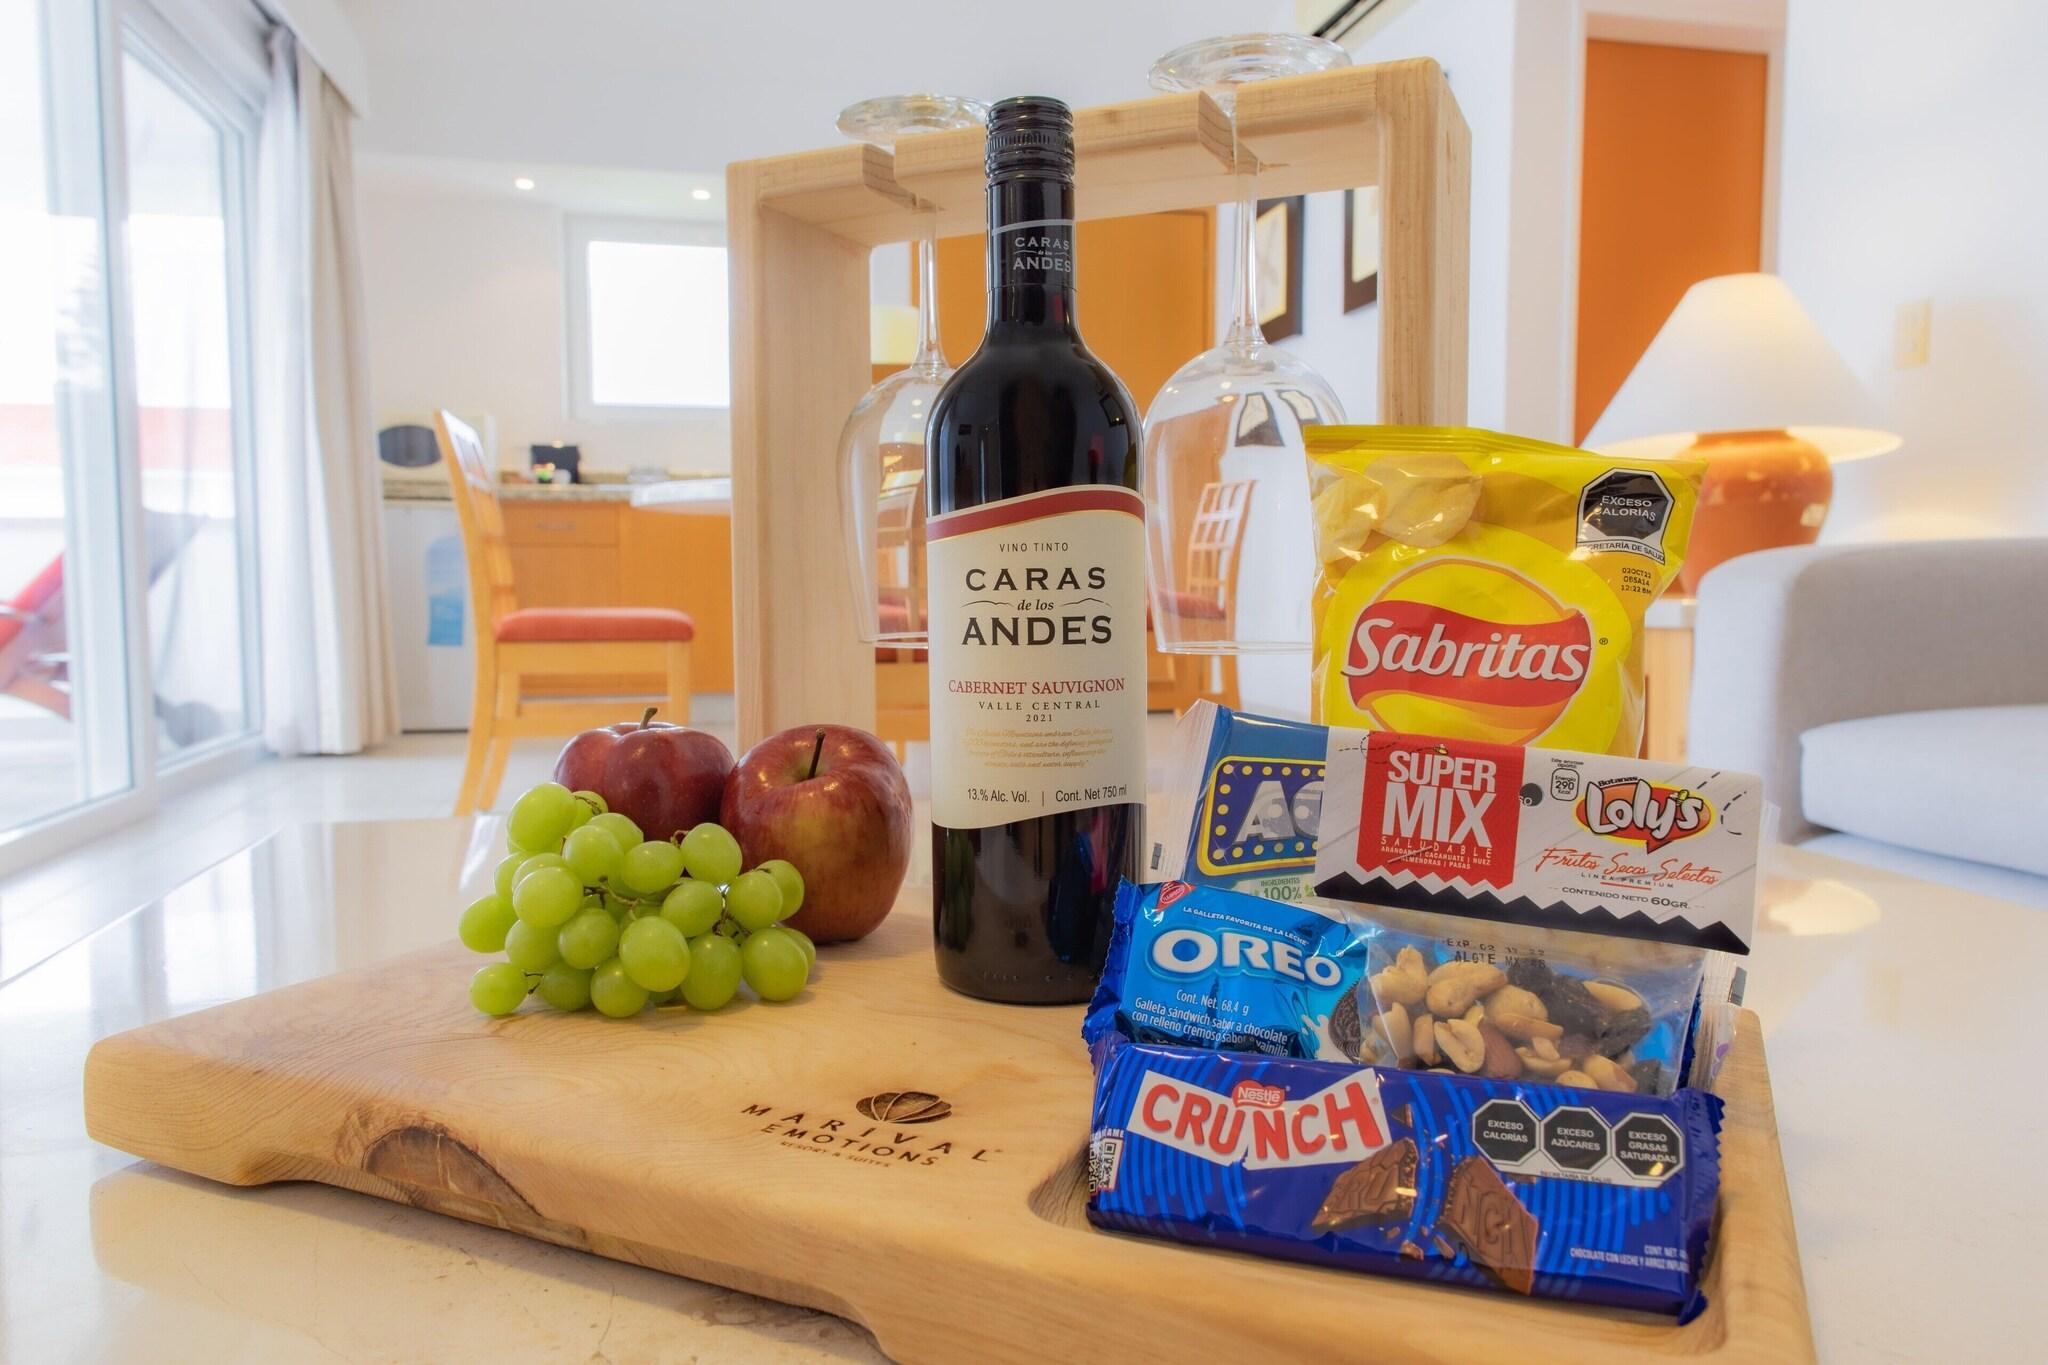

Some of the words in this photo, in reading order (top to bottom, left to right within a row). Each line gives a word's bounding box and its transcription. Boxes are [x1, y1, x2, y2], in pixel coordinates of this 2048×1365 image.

[1014, 236, 1070, 250] CARAS
[1012, 256, 1072, 273] ANDES
[1601, 495, 1652, 508] EXCESO
[999, 543, 1028, 553] VINO
[1033, 542, 1069, 552] TINTO
[1580, 541, 1630, 551] CRETARÍA
[965, 566, 1107, 592] CARAS
[1017, 599, 1033, 611] de
[1035, 599, 1055, 611] los
[961, 615, 1112, 647] ANDES
[1341, 618, 1592, 683] Sabritas
[949, 680, 1027, 695] CABERNET
[1031, 678, 1125, 695] SAUVIGNON
[979, 701, 1023, 711] VALLE
[1032, 700, 1101, 711] CENTRAL
[1025, 714, 1053, 722] 2021
[1387, 750, 1497, 793] SUPER
[1555, 780, 1575, 791] 290
[1598, 776, 1638, 787] Botanas
[990, 789, 1009, 802] Alc.
[1010, 790, 1030, 803] Vol.
[1055, 790, 1082, 802] Cont.
[1084, 788, 1100, 801] Net
[1102, 785, 1117, 799] 750
[1118, 784, 1127, 796] ml
[1382, 781, 1497, 848] MIX
[1585, 779, 1704, 839] Loly's
[1381, 836, 1493, 858] SALUDABLE
[1424, 851, 1465, 863] CACAHUATE
[1472, 857, 1491, 866] NUEZ
[1449, 861, 1471, 869] PASAS
[1260, 877, 1301, 887] INGREDIENTES
[1581, 872, 1615, 882] LINEA
[1620, 877, 1675, 889] PREMIUM
[1263, 885, 1302, 901] 100%
[1562, 886, 1621, 900] CONTENIDO
[1621, 894, 1649, 903] NETO
[1193, 909, 1225, 921] GALLETA
[1225, 915, 1262, 930] FAVORITA
[1262, 925, 1273, 933] DE
[1274, 928, 1284, 936] LA
[1152, 929, 1343, 987] OREO
[1176, 989, 1198, 1005] Cont.
[1201, 995, 1219, 1010] Net.
[1242, 1004, 1250, 1016] g
[1135, 997, 1167, 1016] Galleta
[1167, 1006, 1211, 1026] sándwich
[1211, 1016, 1234, 1031] sabor
[1235, 1021, 1242, 1032] a
[1243, 1023, 1289, 1046] chocolate
[1131, 1010, 1148, 1023] con
[1149, 1014, 1182, 1033] relleno
[1182, 1023, 1222, 1042] cremoso
[1254, 1039, 1289, 1057] vainilla
[1141, 1080, 1385, 1162] CRUNCH
[1487, 1119, 1524, 1131] EXCESO
[740, 1103, 989, 1162] MARIVAL
[1483, 1130, 1529, 1143] CALORÍAS
[1556, 1126, 1595, 1139] EXCESO
[1628, 1130, 1668, 1143] EXCESO
[760, 1123, 940, 1166] EMOTIONS
[1550, 1136, 1600, 1151] AZÚCARES
[1628, 1141, 1668, 1153] GRASAS
[1619, 1150, 1677, 1164] SATURADAS
